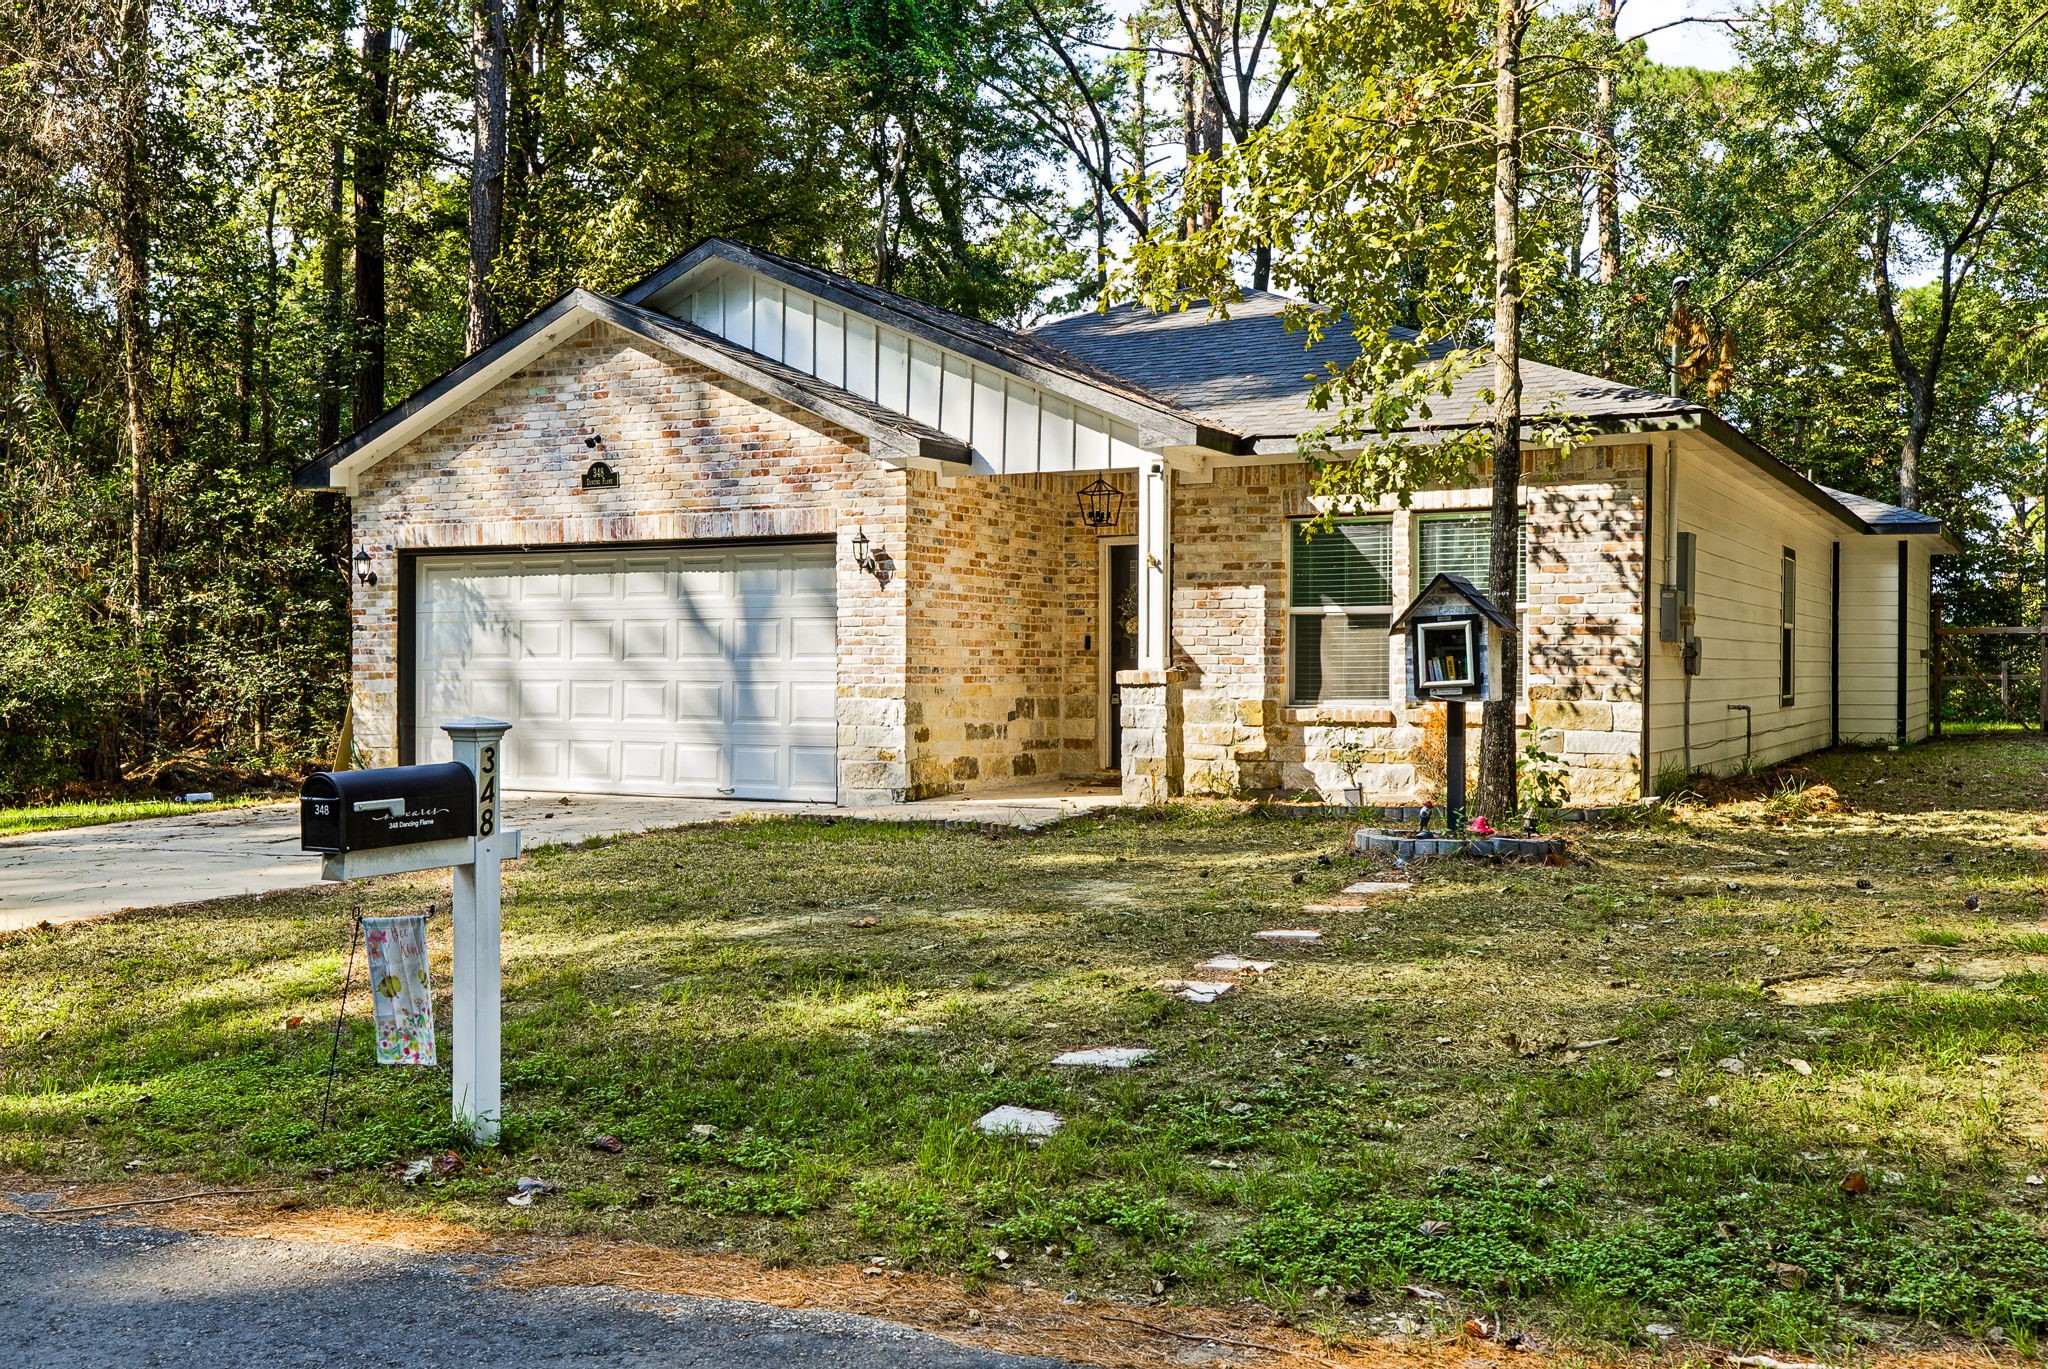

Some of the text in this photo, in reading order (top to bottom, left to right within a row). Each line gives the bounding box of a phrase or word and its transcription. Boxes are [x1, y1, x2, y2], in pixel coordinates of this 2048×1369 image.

[592, 467, 604, 478] 348
[480, 747, 495, 836] 348
[314, 804, 330, 816] 348
[400, 820, 419, 828] Dancing
